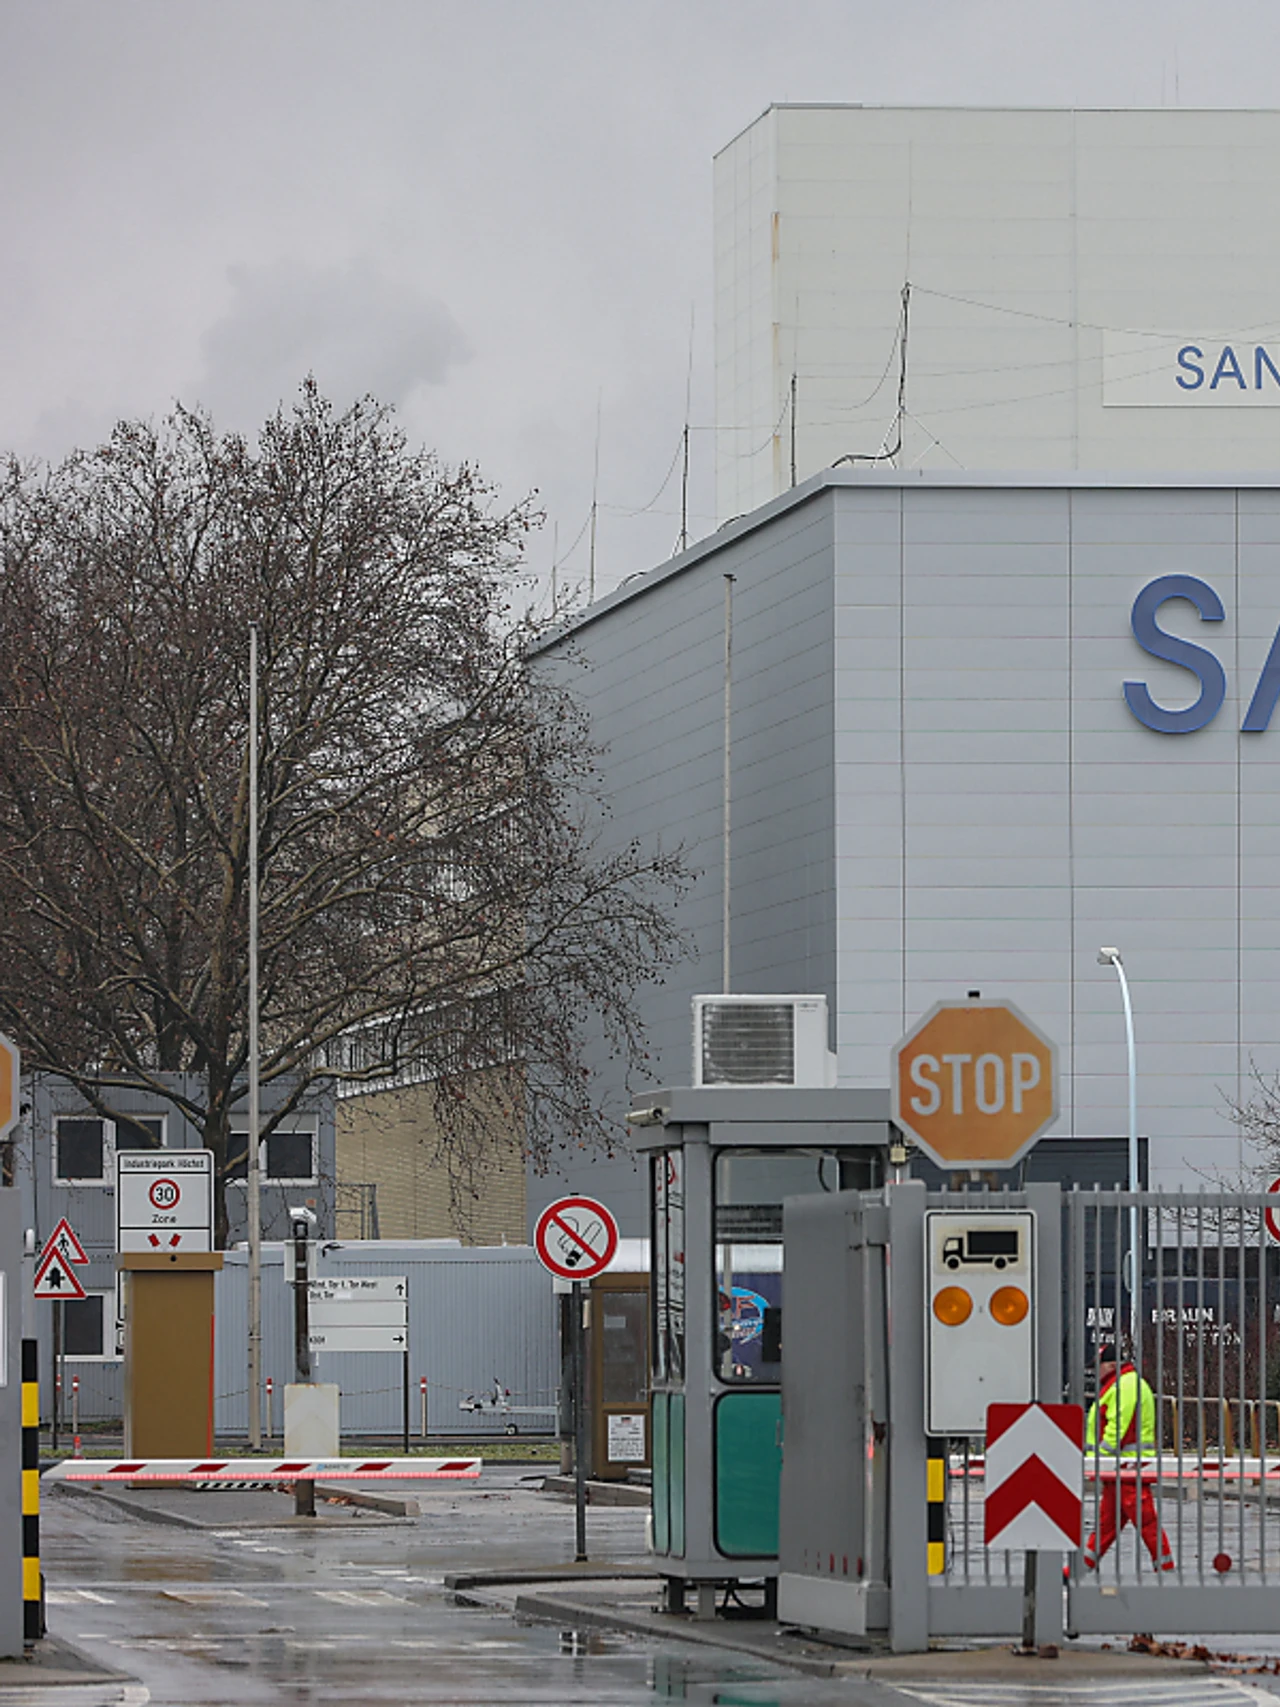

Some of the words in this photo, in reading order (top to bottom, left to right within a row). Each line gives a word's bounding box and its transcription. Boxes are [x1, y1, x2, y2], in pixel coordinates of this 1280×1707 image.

[910, 1053, 1041, 1116] STOP
[155, 1186, 175, 1203] 30
[151, 1213, 178, 1224] Zone
